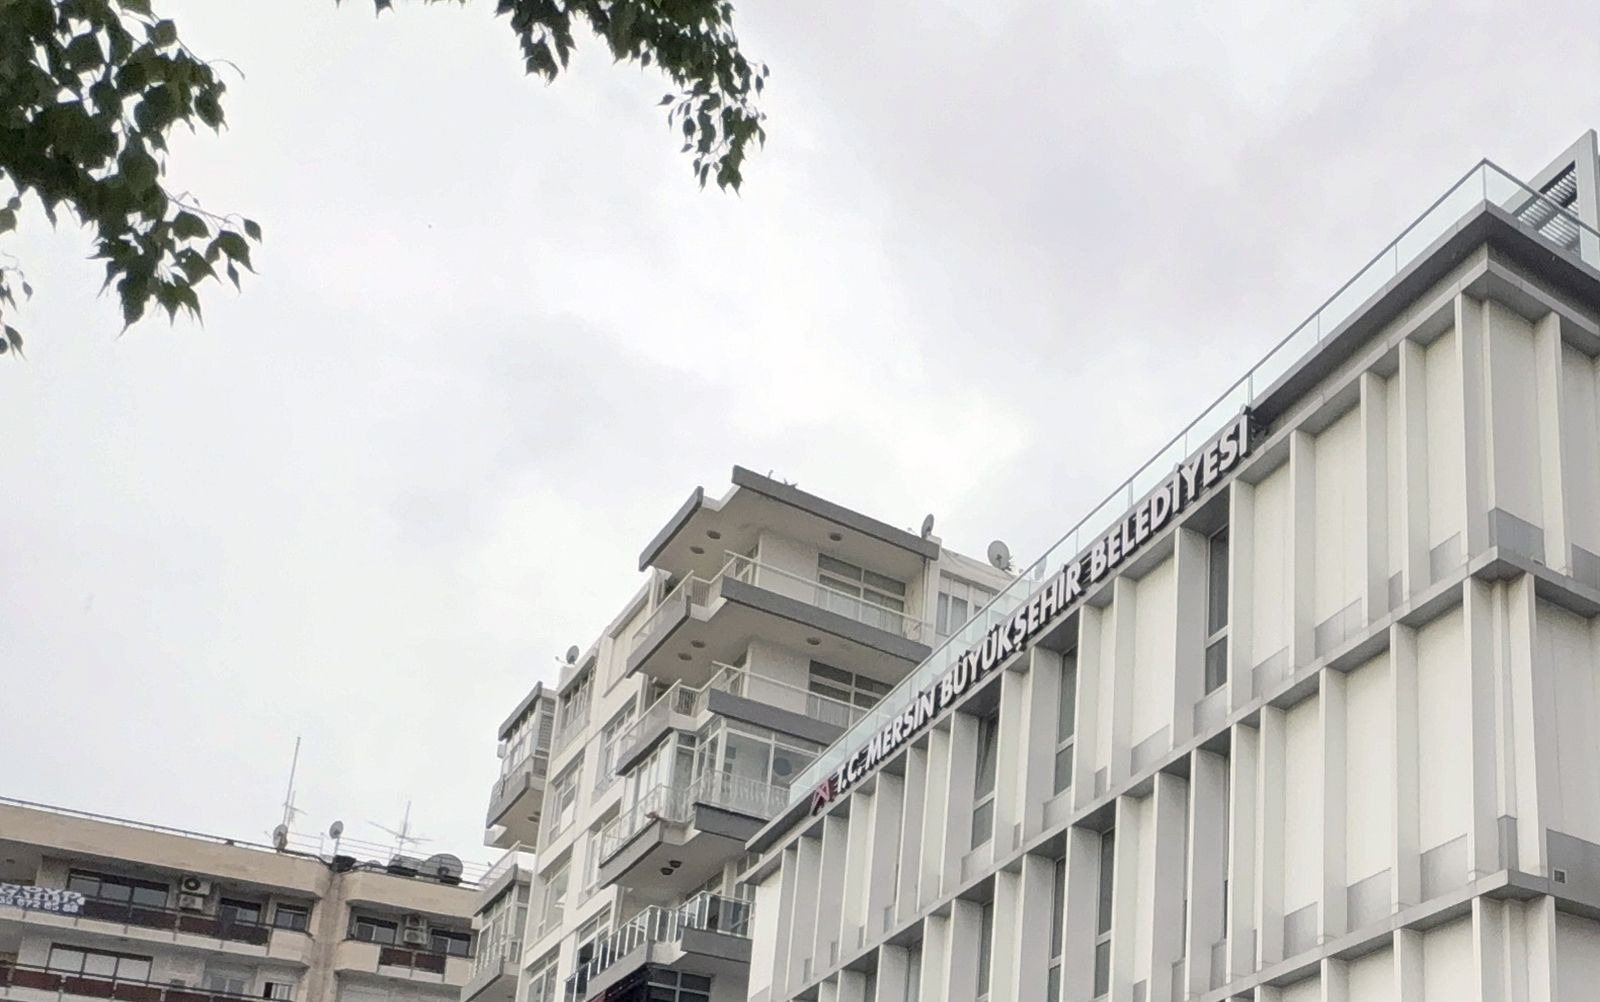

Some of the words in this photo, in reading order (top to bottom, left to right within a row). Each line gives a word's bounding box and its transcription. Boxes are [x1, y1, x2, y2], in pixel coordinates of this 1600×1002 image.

[836, 752, 863, 793] T.C.
[865, 683, 936, 770] MERSİN
[939, 560, 1081, 707] BÜYÜKŞEHİR
[1090, 403, 1249, 582] BELEDİYESİ
